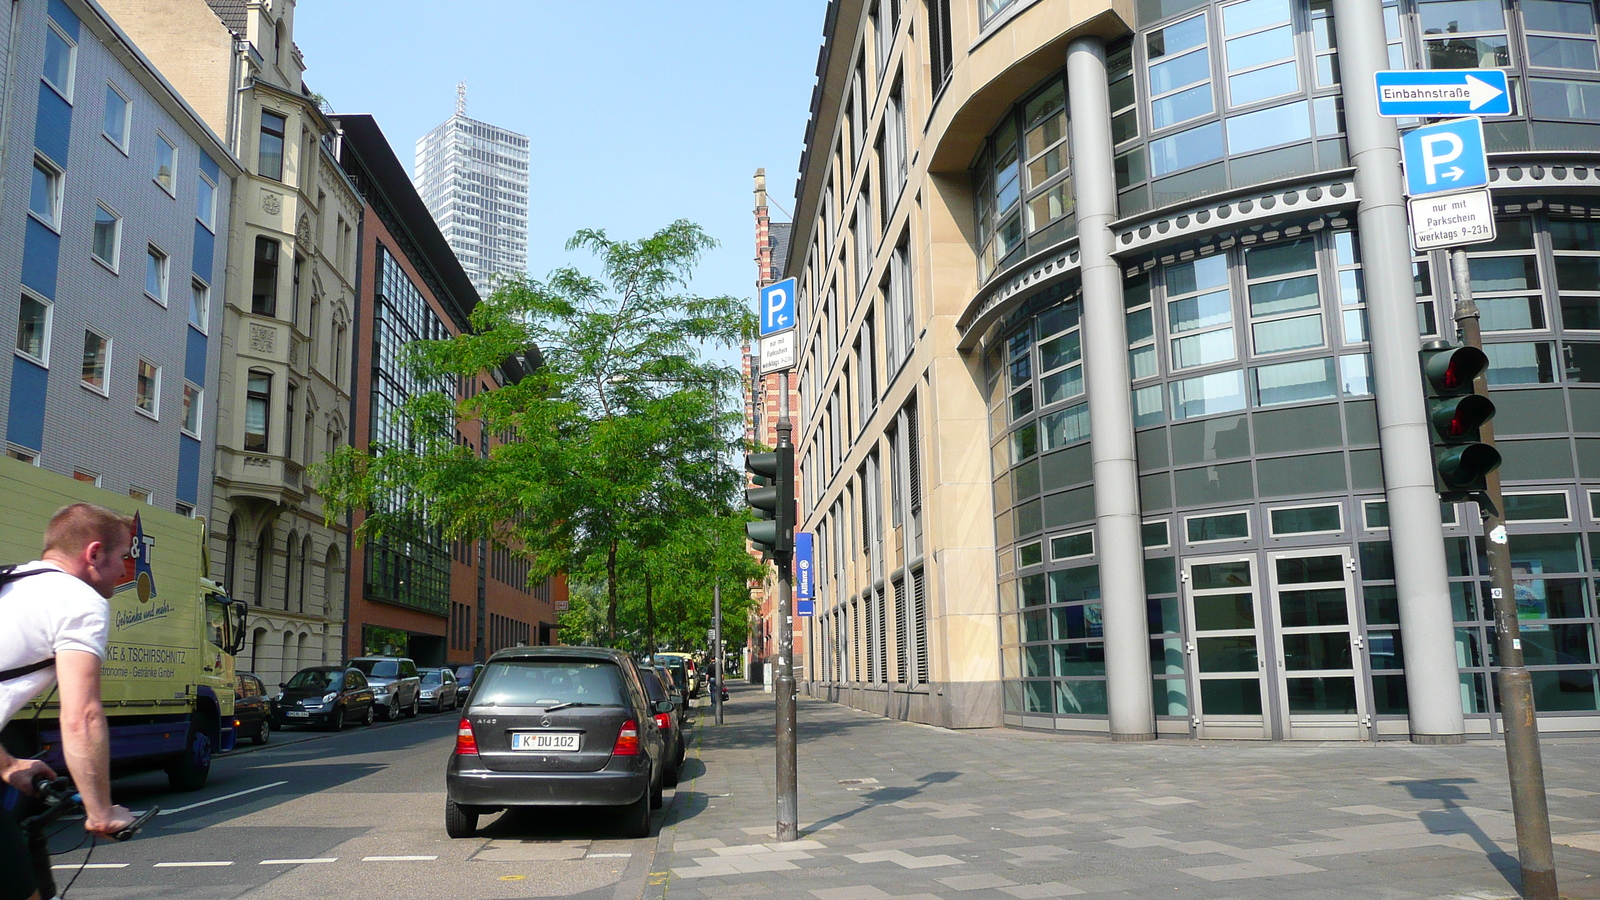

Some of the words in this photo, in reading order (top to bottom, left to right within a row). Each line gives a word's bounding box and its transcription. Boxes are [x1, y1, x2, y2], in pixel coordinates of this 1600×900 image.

[1383, 87, 1471, 99] Einbahnstraße
[1420, 131, 1464, 186] P
[1432, 203, 1447, 213] nur
[1452, 199, 1467, 210] mit
[1427, 212, 1476, 227] Parkschein
[1419, 230, 1458, 243] werktags
[768, 288, 787, 328] P
[130, 536, 141, 559] &
[142, 534, 155, 564] T
[143, 602, 155, 619] und
[120, 647, 126, 661] &
[128, 647, 186, 664] TSCHIRSCHNITZ
[132, 666, 157, 678] Getränke
[158, 667, 175, 678] GmbH
[523, 735, 531, 747] K
[537, 736, 552, 747] DU
[553, 736, 574, 747] 102
